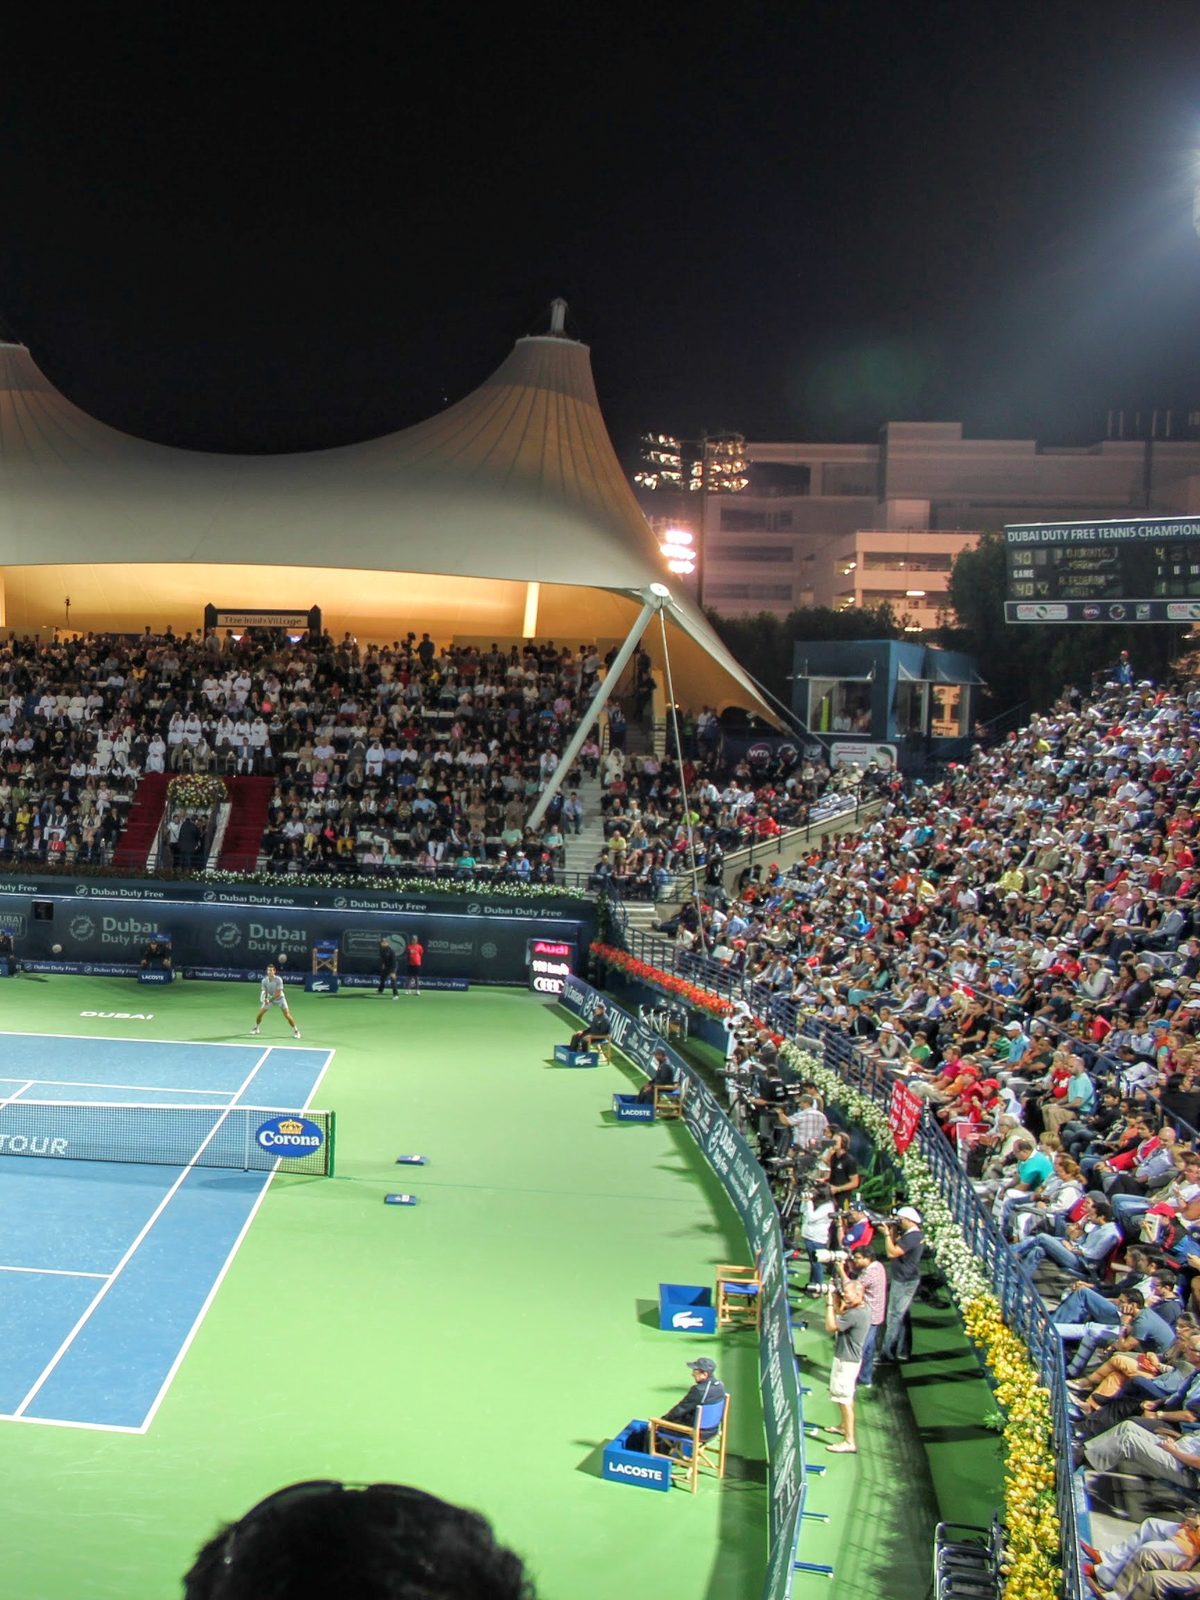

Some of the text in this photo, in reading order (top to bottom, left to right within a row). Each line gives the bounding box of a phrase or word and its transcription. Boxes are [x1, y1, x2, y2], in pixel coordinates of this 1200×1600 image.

[1007, 530, 1040, 542] DUBAI
[1041, 529, 1069, 541] DUTY
[1071, 528, 1095, 540] FREE
[1098, 526, 1136, 539] TENNIS
[1013, 569, 1034, 578] GAME
[18, 884, 38, 892] Free
[91, 888, 164, 898] Dubai Duty Free
[219, 893, 294, 905] Dubai Duty Free
[350, 900, 427, 911] Dubai Duty Free
[484, 906, 562, 917] Dubai Duty Free
[102, 917, 158, 933] Dubai
[249, 923, 307, 941] Dubai
[101, 933, 131, 945] Duty
[248, 940, 278, 953] Duty
[281, 942, 307, 953] Free
[535, 942, 569, 956] Audi
[79, 1011, 154, 1020] DUBAI
[620, 1109, 652, 1118] LACOSTE
[259, 1130, 320, 1146] Corona
[609, 1461, 663, 1481] LACOSTE
